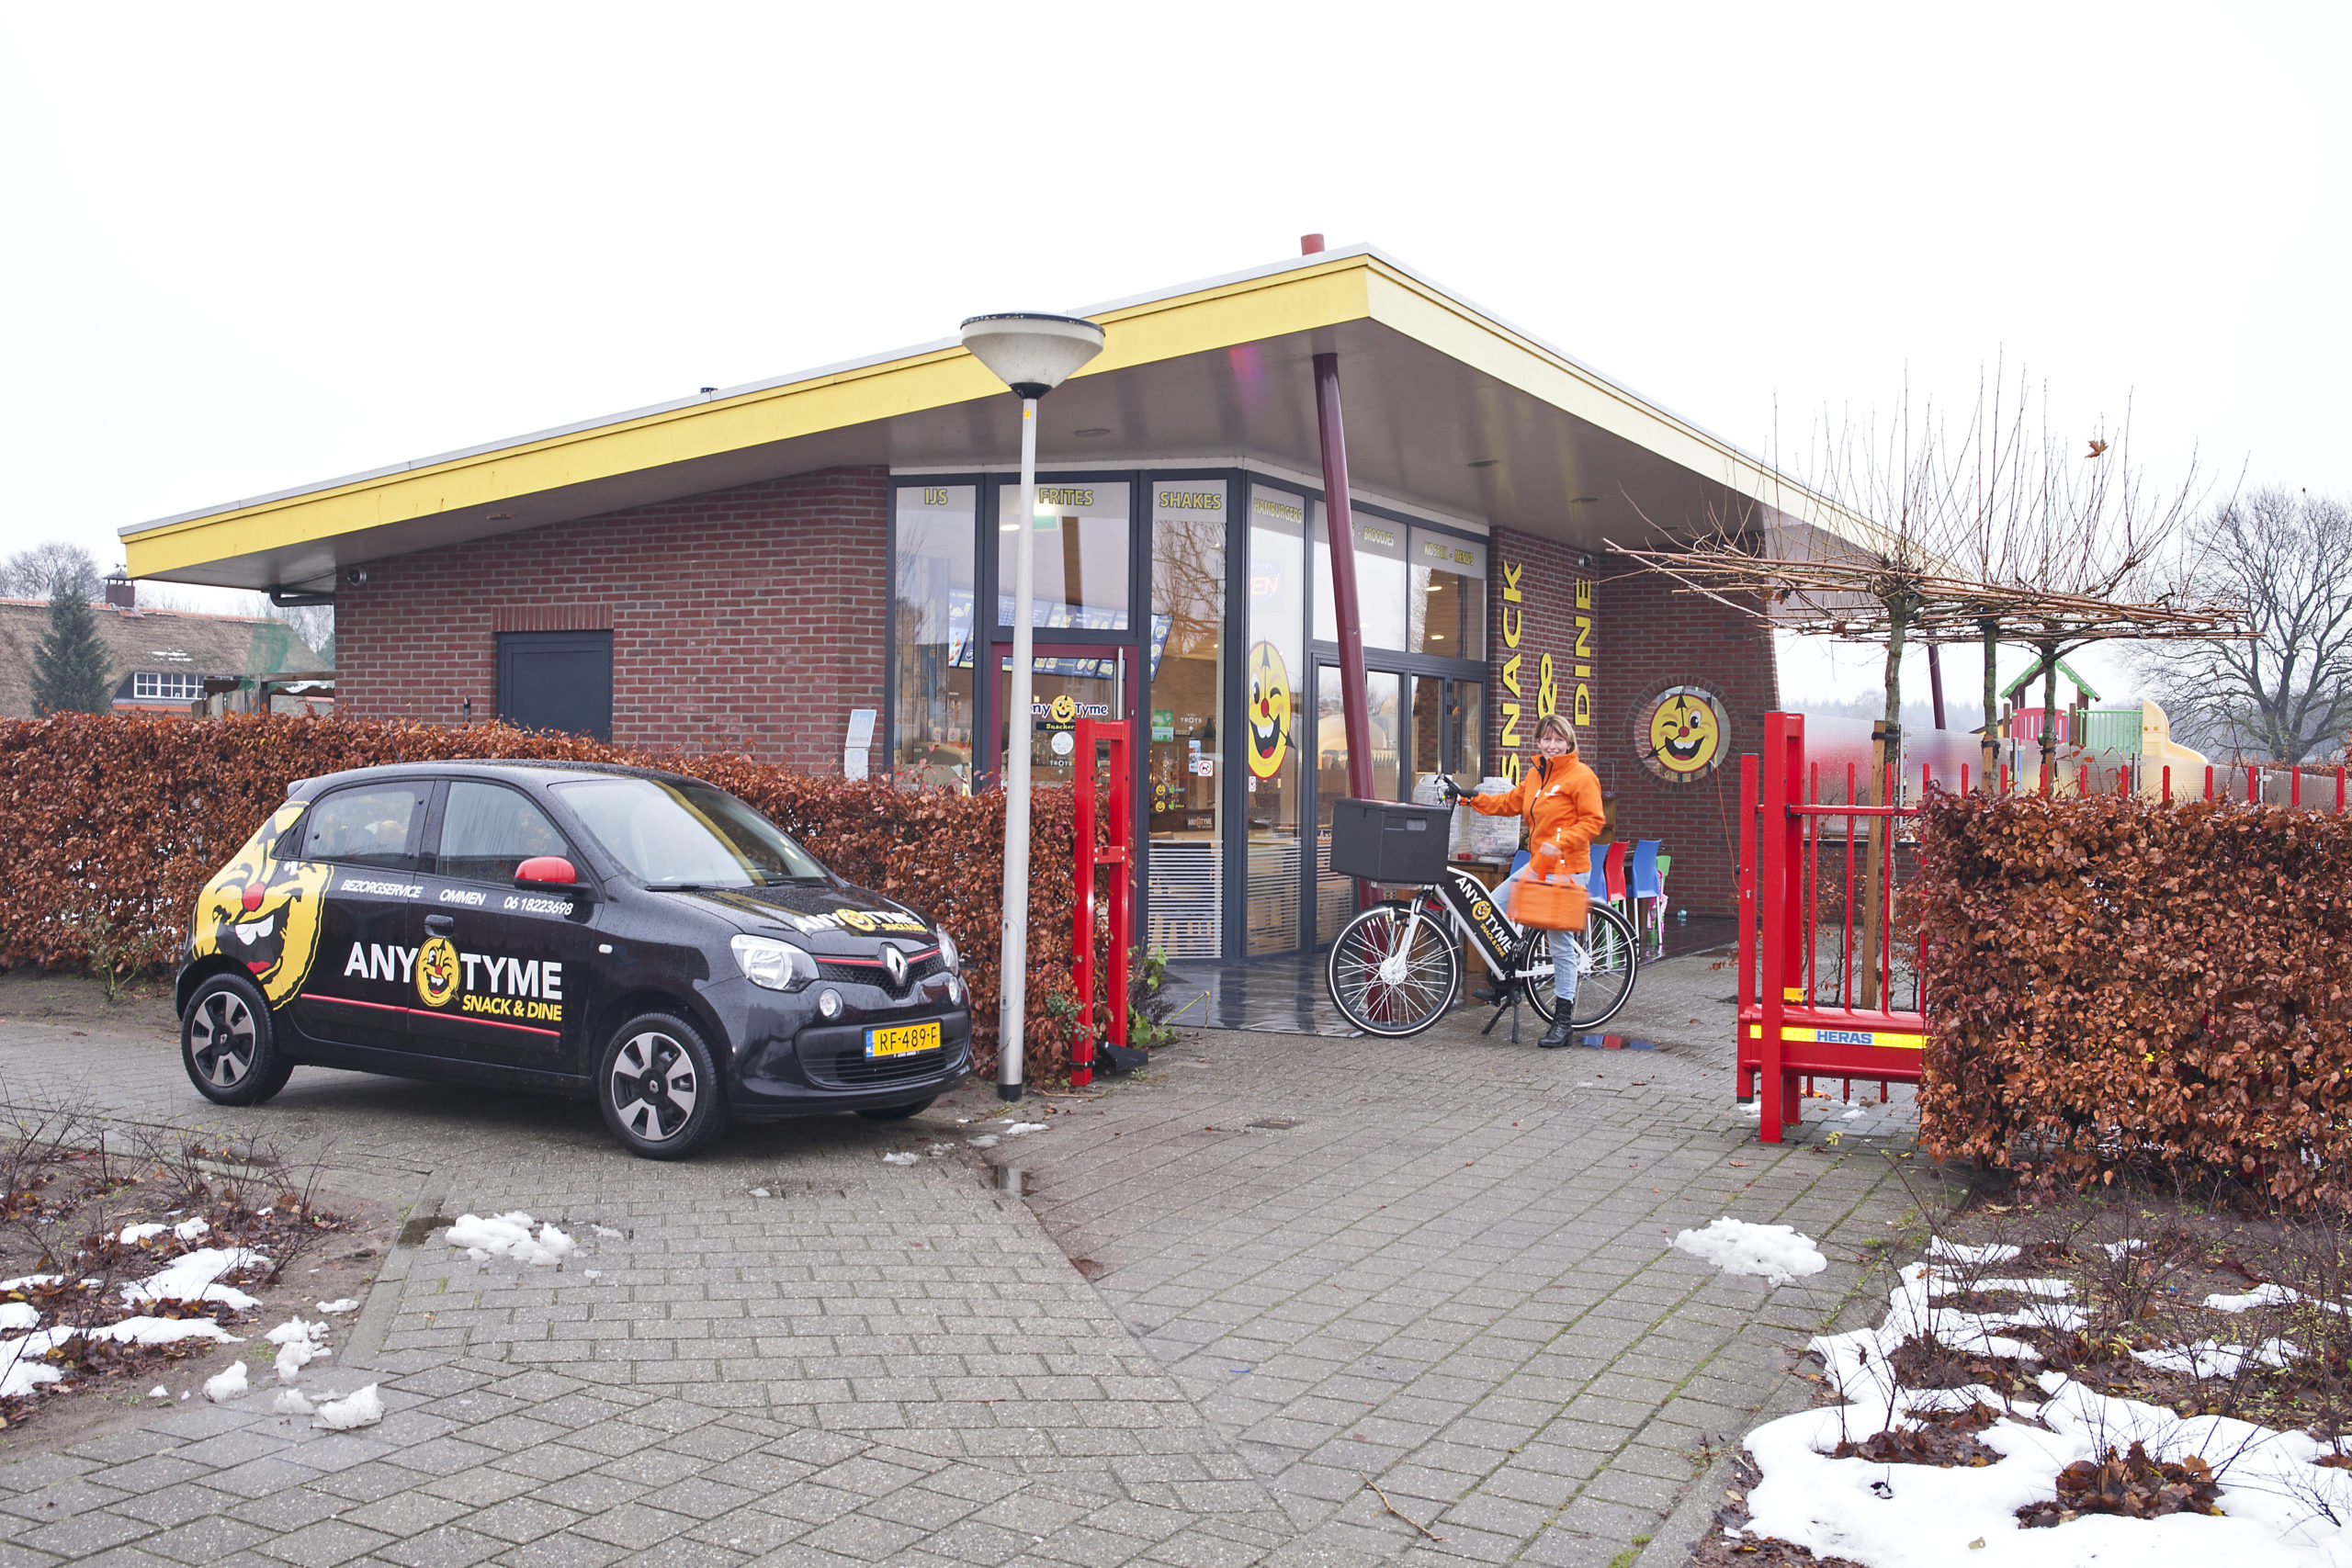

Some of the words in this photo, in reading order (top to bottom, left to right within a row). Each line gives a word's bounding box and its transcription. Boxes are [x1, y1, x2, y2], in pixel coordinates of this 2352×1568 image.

[924, 488, 948, 505] IJS
[1039, 488, 1093, 506] FRITES
[1159, 491, 1222, 510] SHAKES
[1253, 498, 1302, 525] HAMBURGERS
[1363, 526, 1394, 547] BROODJES
[1424, 541, 1448, 560] KIDSBOX
[1454, 549, 1474, 566] MENU'S
[1250, 577, 1278, 595] EN
[1575, 578, 1591, 726] DINE
[1501, 559, 1522, 787] SNACK
[1537, 653, 1557, 719] &
[1032, 704, 1051, 717] ny
[1075, 703, 1108, 717] Tyme
[1046, 722, 1075, 730] Snacker
[341, 879, 424, 898] BEZORGSERVICE
[439, 888, 487, 906] OMMEN
[504, 896, 518, 909] 06
[520, 897, 573, 916] 18223698
[1455, 876, 1482, 904] ANY
[1486, 914, 1512, 953] TYME
[344, 942, 419, 983] ANY
[459, 953, 562, 1000] TYME
[462, 995, 513, 1015] SNACK
[513, 1002, 526, 1018] &
[526, 1001, 562, 1021] DINE
[880, 1026, 936, 1051] RF-489-F
[1816, 1030, 1872, 1044] HERAS
